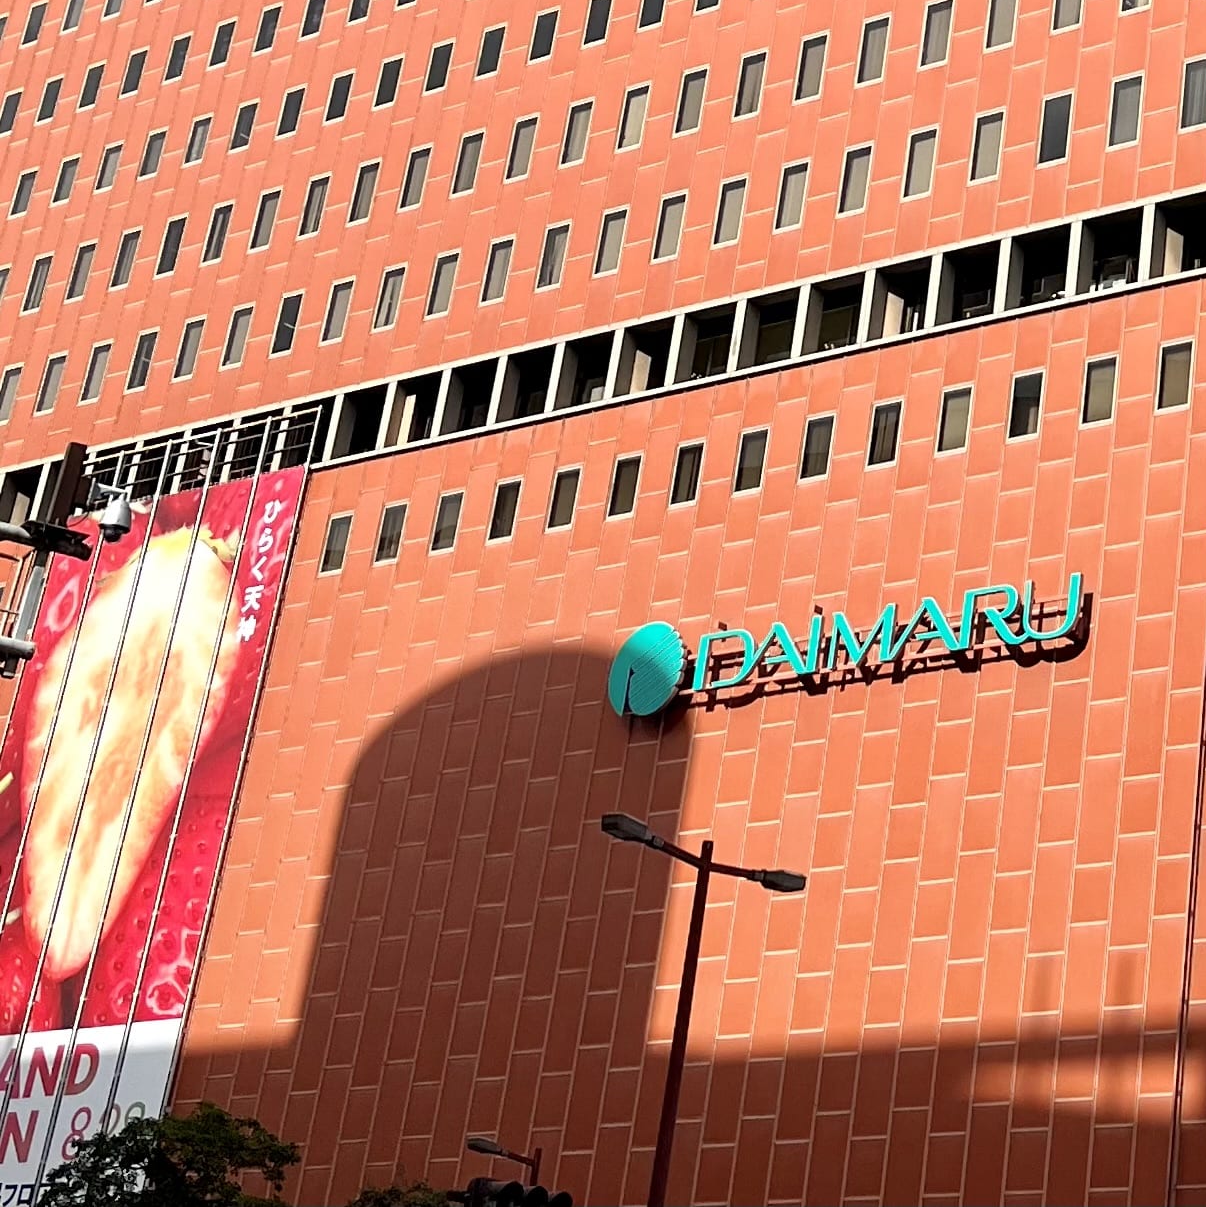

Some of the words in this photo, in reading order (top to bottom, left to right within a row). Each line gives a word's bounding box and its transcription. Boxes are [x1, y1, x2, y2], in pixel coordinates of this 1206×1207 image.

[235, 499, 284, 643] ひらく天神
[691, 571, 1083, 693] DAIMARU
